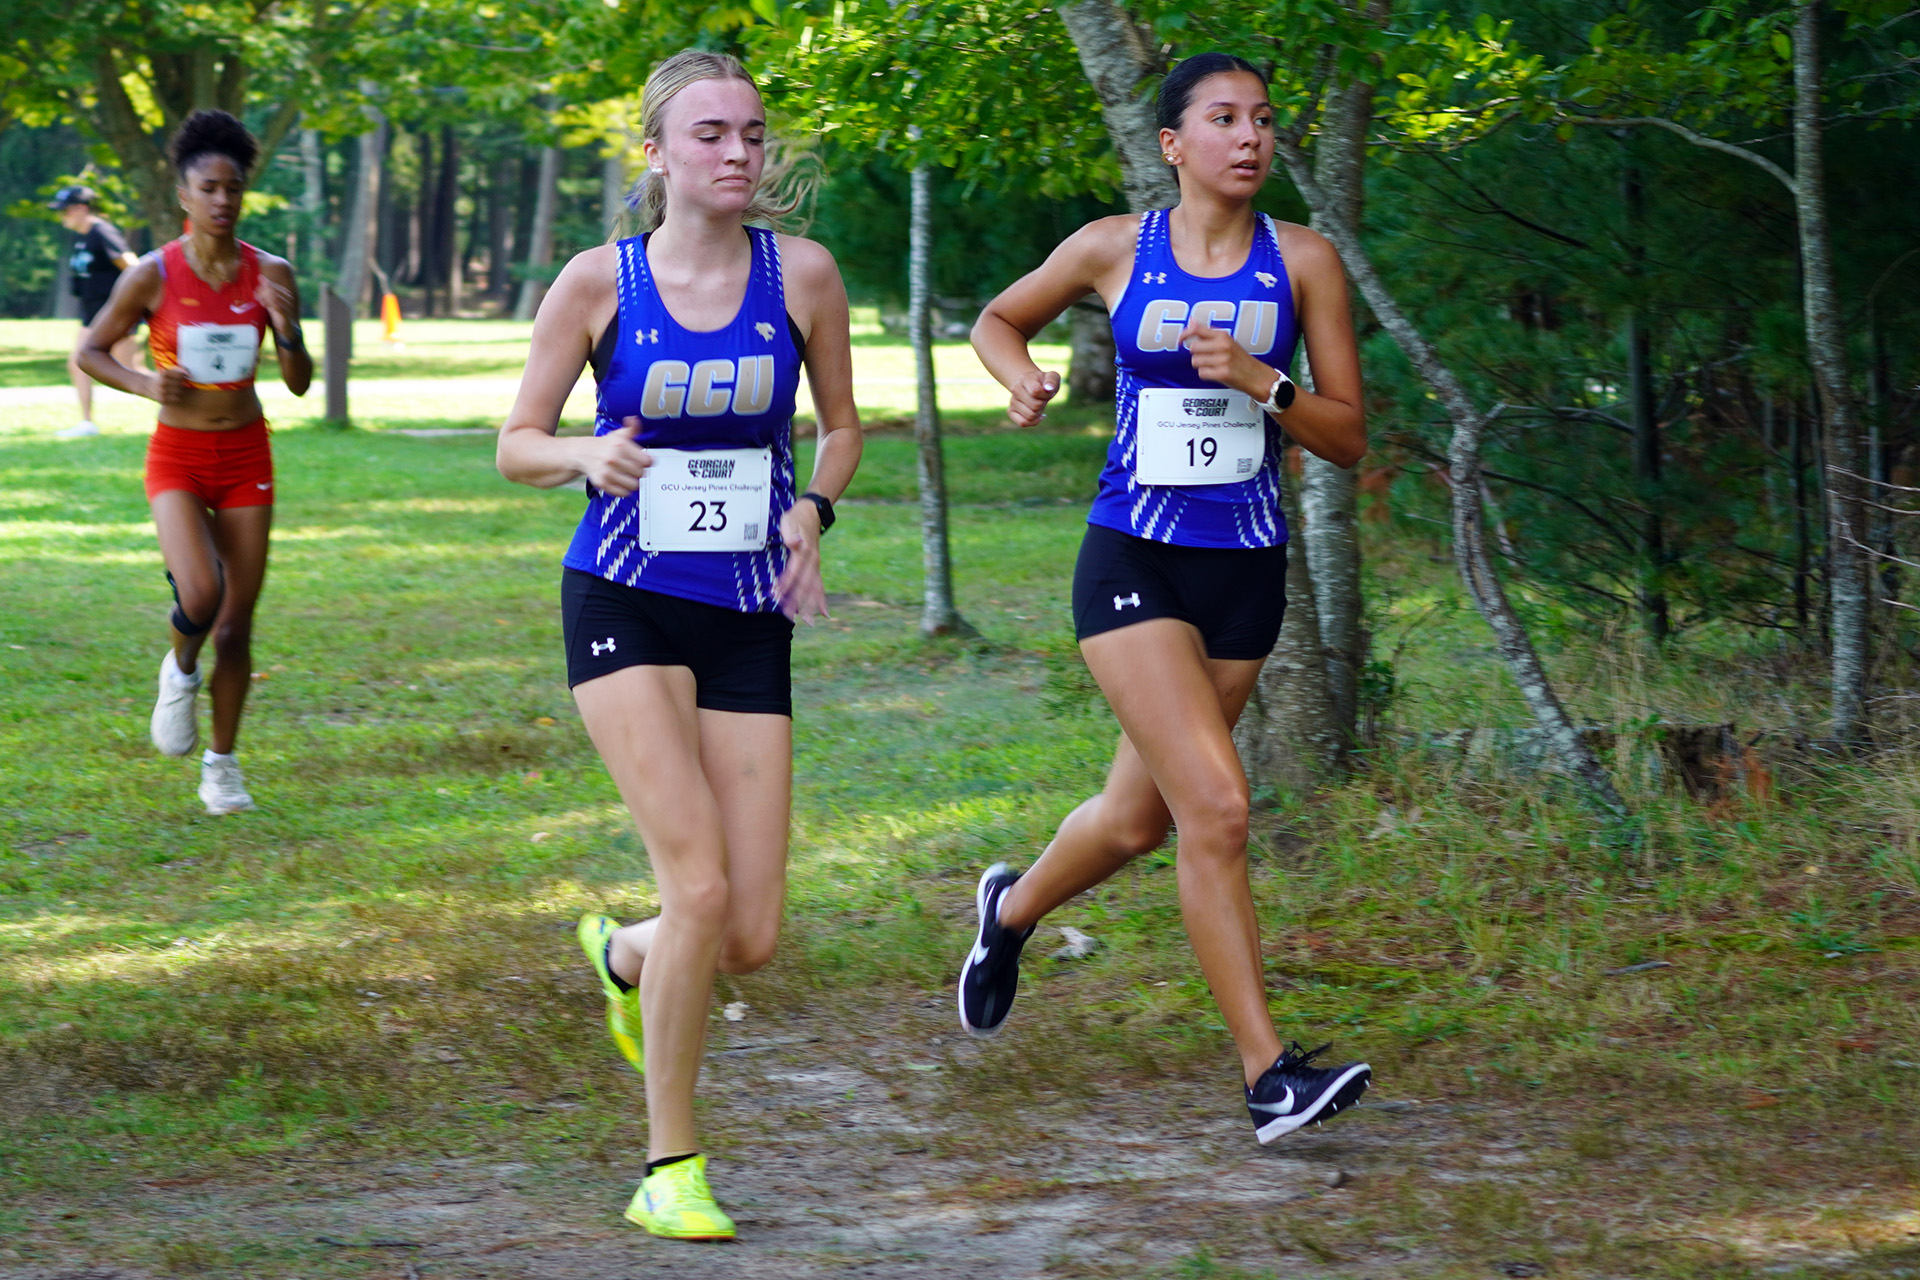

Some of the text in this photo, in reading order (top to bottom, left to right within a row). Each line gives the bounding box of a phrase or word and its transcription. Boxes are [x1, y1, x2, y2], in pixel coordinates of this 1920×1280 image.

[1136, 299, 1279, 355] GCU
[640, 354, 775, 420] GCU
[1182, 398, 1230, 408] GEORGIAN
[1195, 407, 1228, 417] COURT
[1157, 420, 1175, 428] GCU
[1177, 421, 1201, 430] Jersey
[1222, 421, 1257, 430] Challenge
[1186, 436, 1218, 468] 19
[687, 459, 736, 469] GEORGIAN
[701, 469, 733, 479] COURT
[660, 483, 680, 491] GCU
[681, 484, 707, 492] Jersey
[729, 483, 763, 492] Challenge
[688, 500, 728, 532] 23
